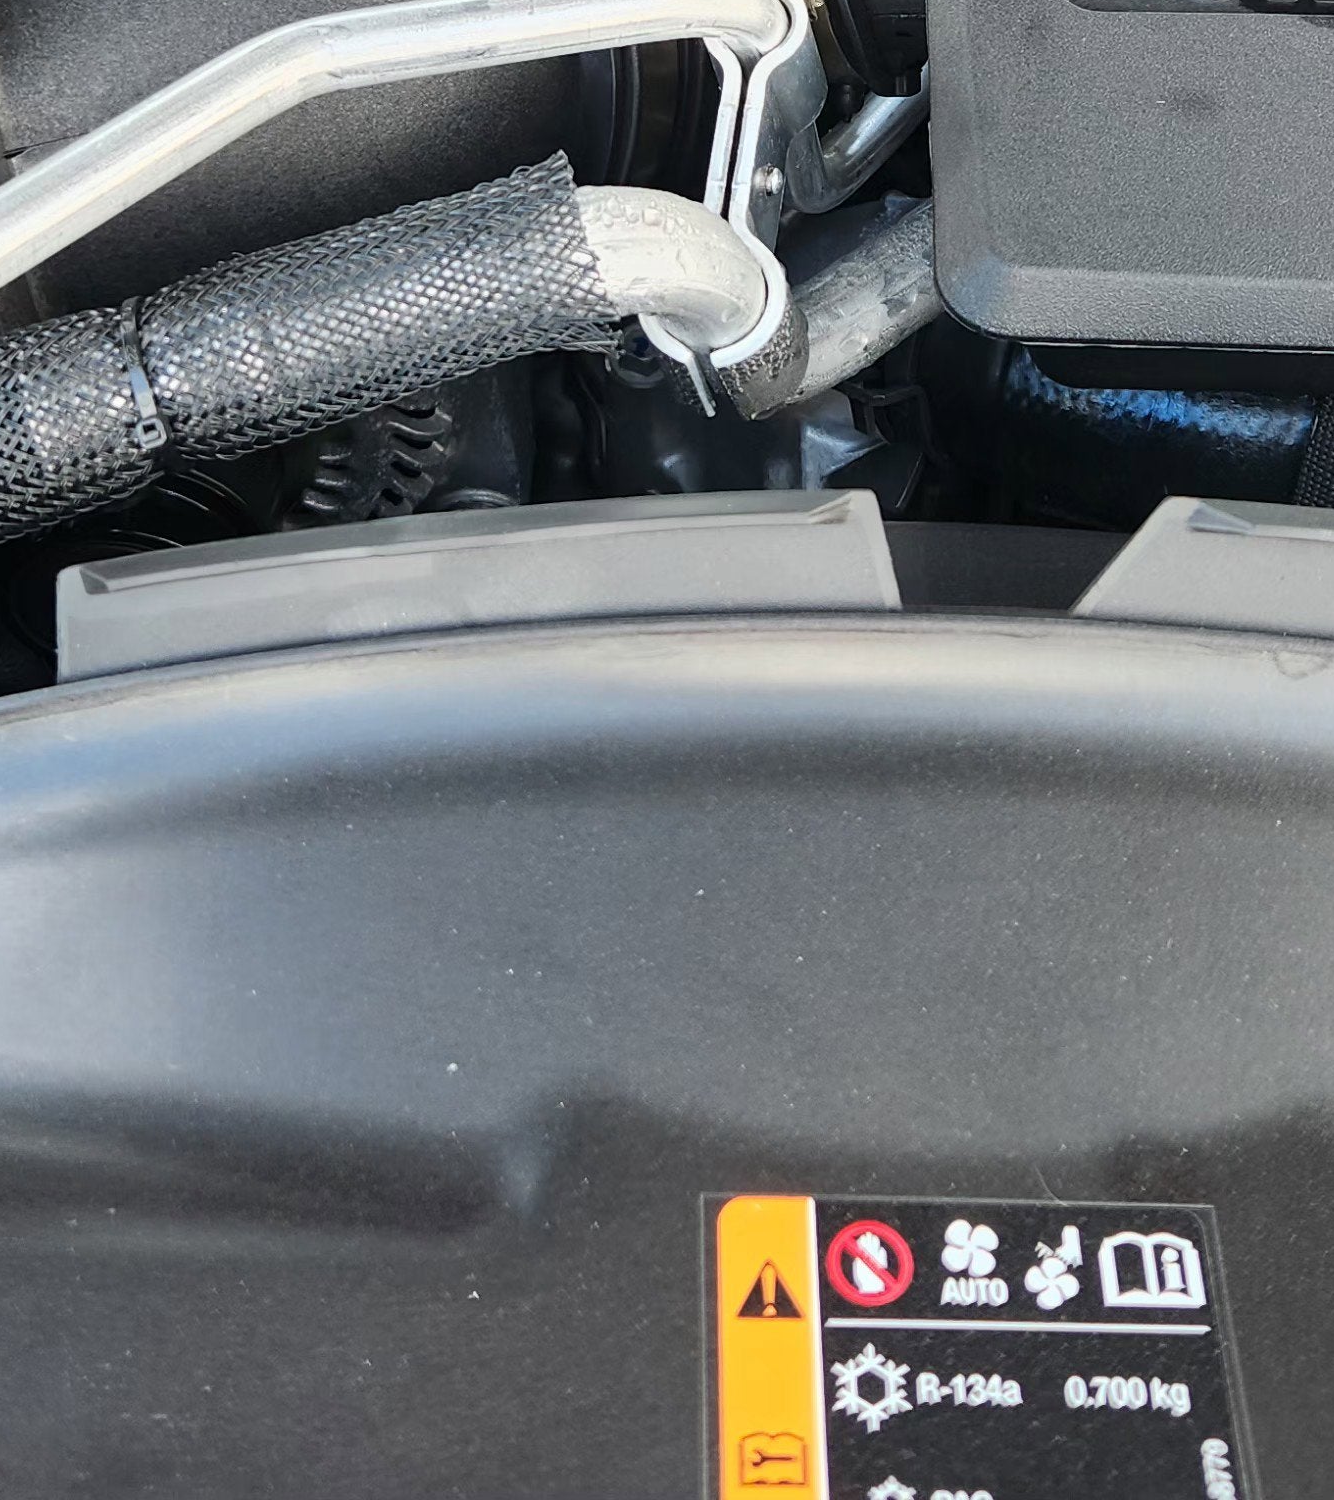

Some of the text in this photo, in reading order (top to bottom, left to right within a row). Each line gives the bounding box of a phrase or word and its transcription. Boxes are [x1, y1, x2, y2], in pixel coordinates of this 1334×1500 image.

[940, 1276, 1009, 1307] AUTO
[915, 1371, 1192, 1418] R-134a 0.700 kg
